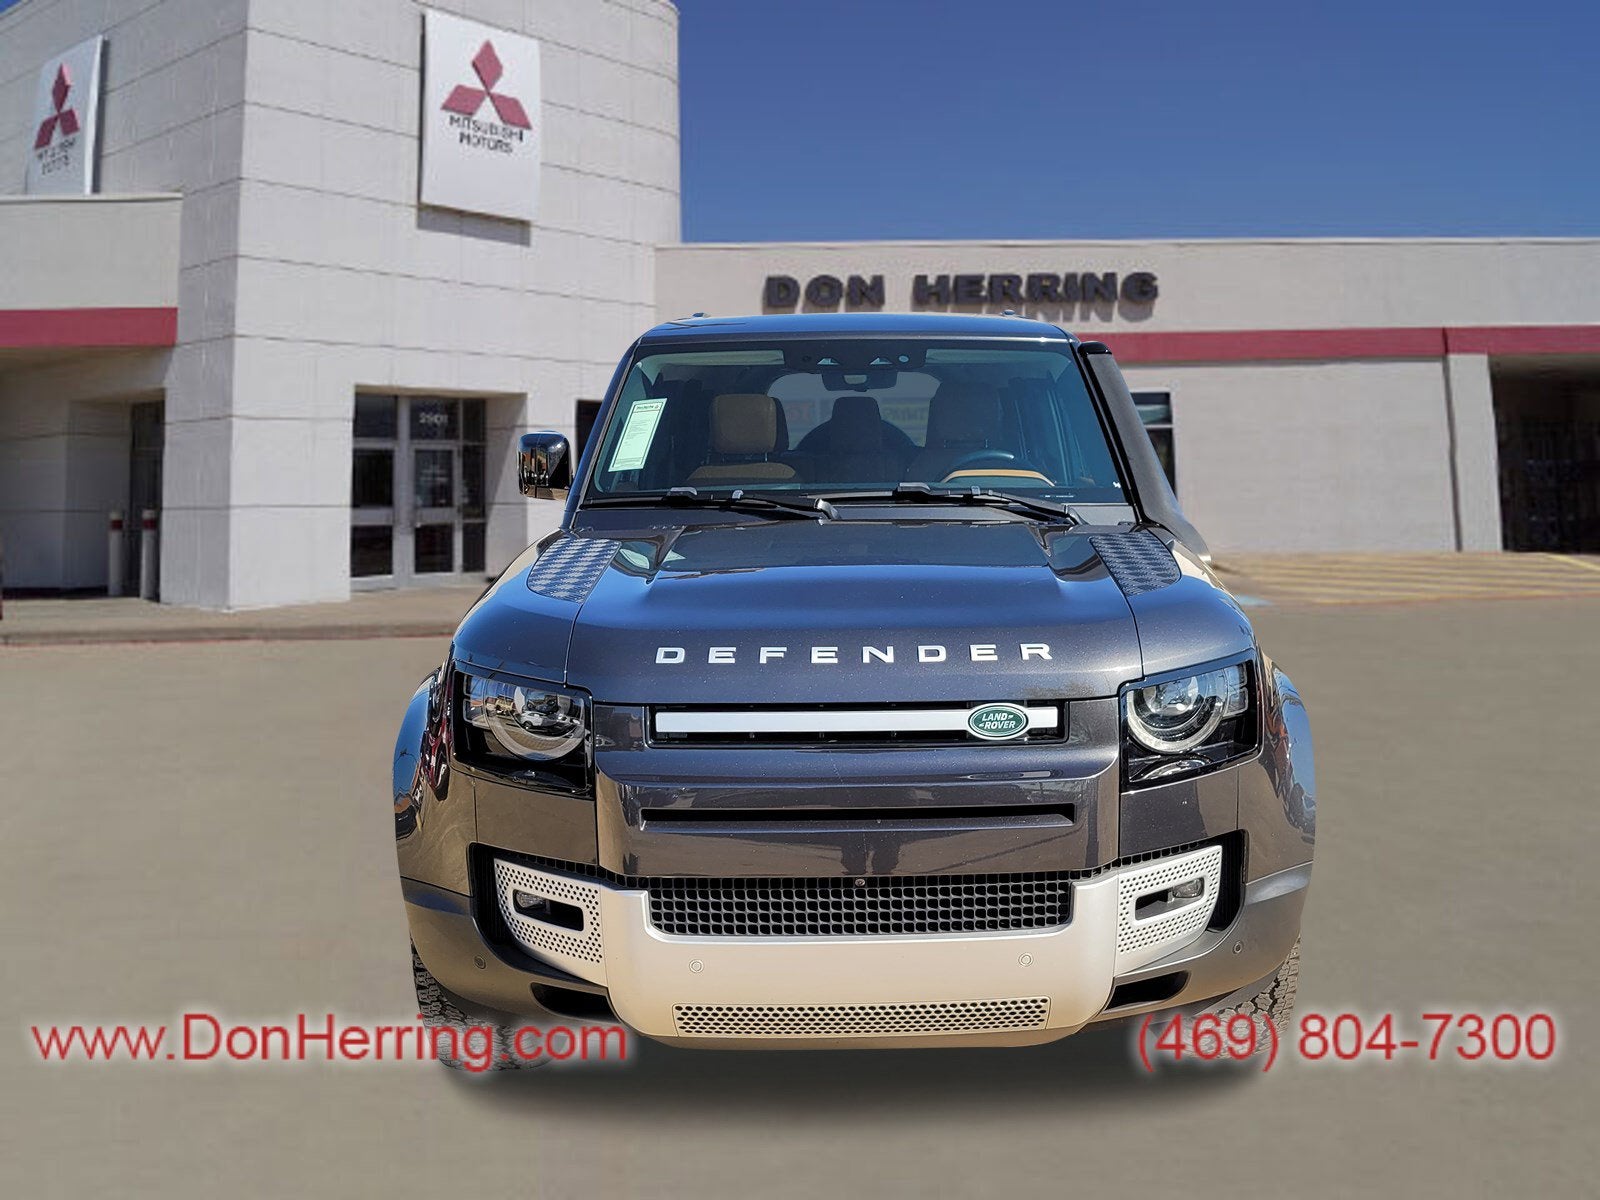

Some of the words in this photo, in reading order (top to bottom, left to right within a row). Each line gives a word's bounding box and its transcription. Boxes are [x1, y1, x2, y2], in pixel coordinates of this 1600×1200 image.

[449, 114, 524, 142] MITSUBISHI
[459, 131, 513, 153] MOTORS
[764, 274, 885, 306] DON
[912, 271, 1159, 306] HERRING
[655, 643, 1053, 665] DEFENDER
[981, 712, 1008, 722] LAND
[983, 720, 1016, 730] ROVER
